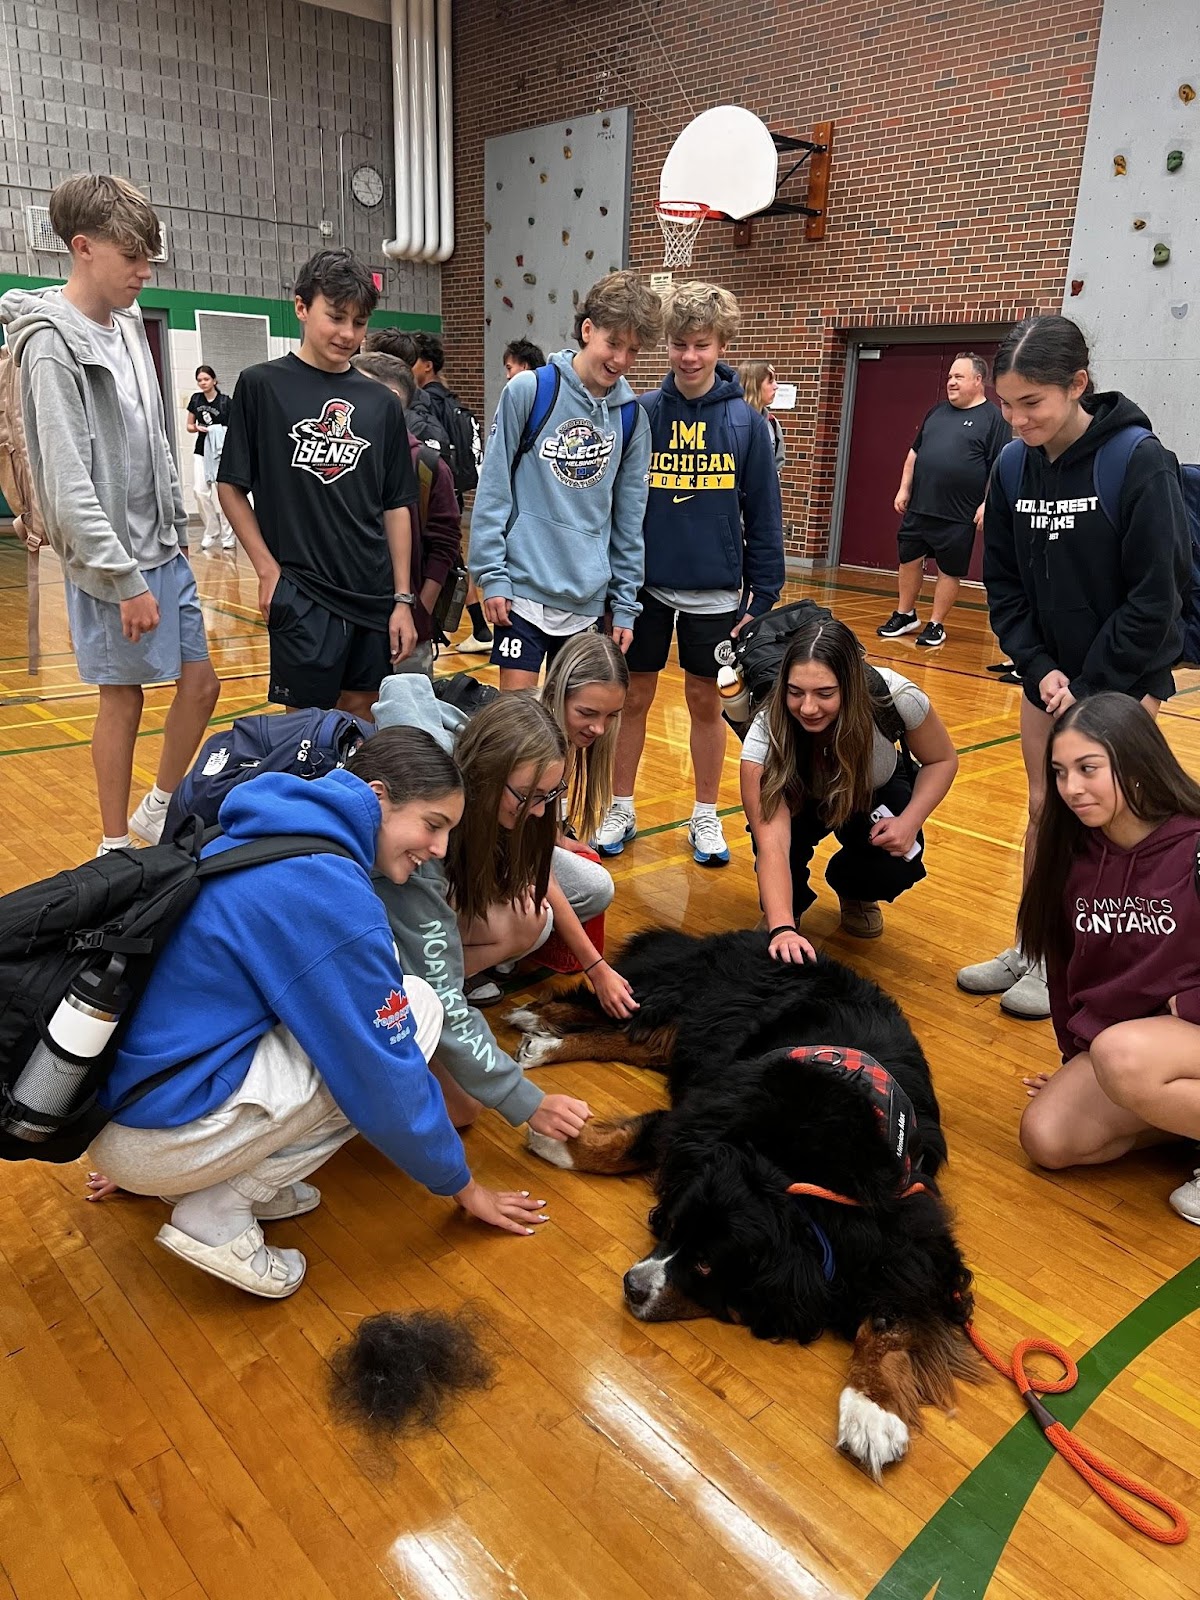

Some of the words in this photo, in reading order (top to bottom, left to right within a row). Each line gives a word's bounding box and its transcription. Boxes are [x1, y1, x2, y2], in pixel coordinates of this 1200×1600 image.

[297, 439, 360, 464] SENS
[543, 434, 614, 460] SELECTS
[649, 476, 722, 487] HOCKEY
[499, 636, 522, 658] 48
[1075, 911, 1177, 935] ONTARIO
